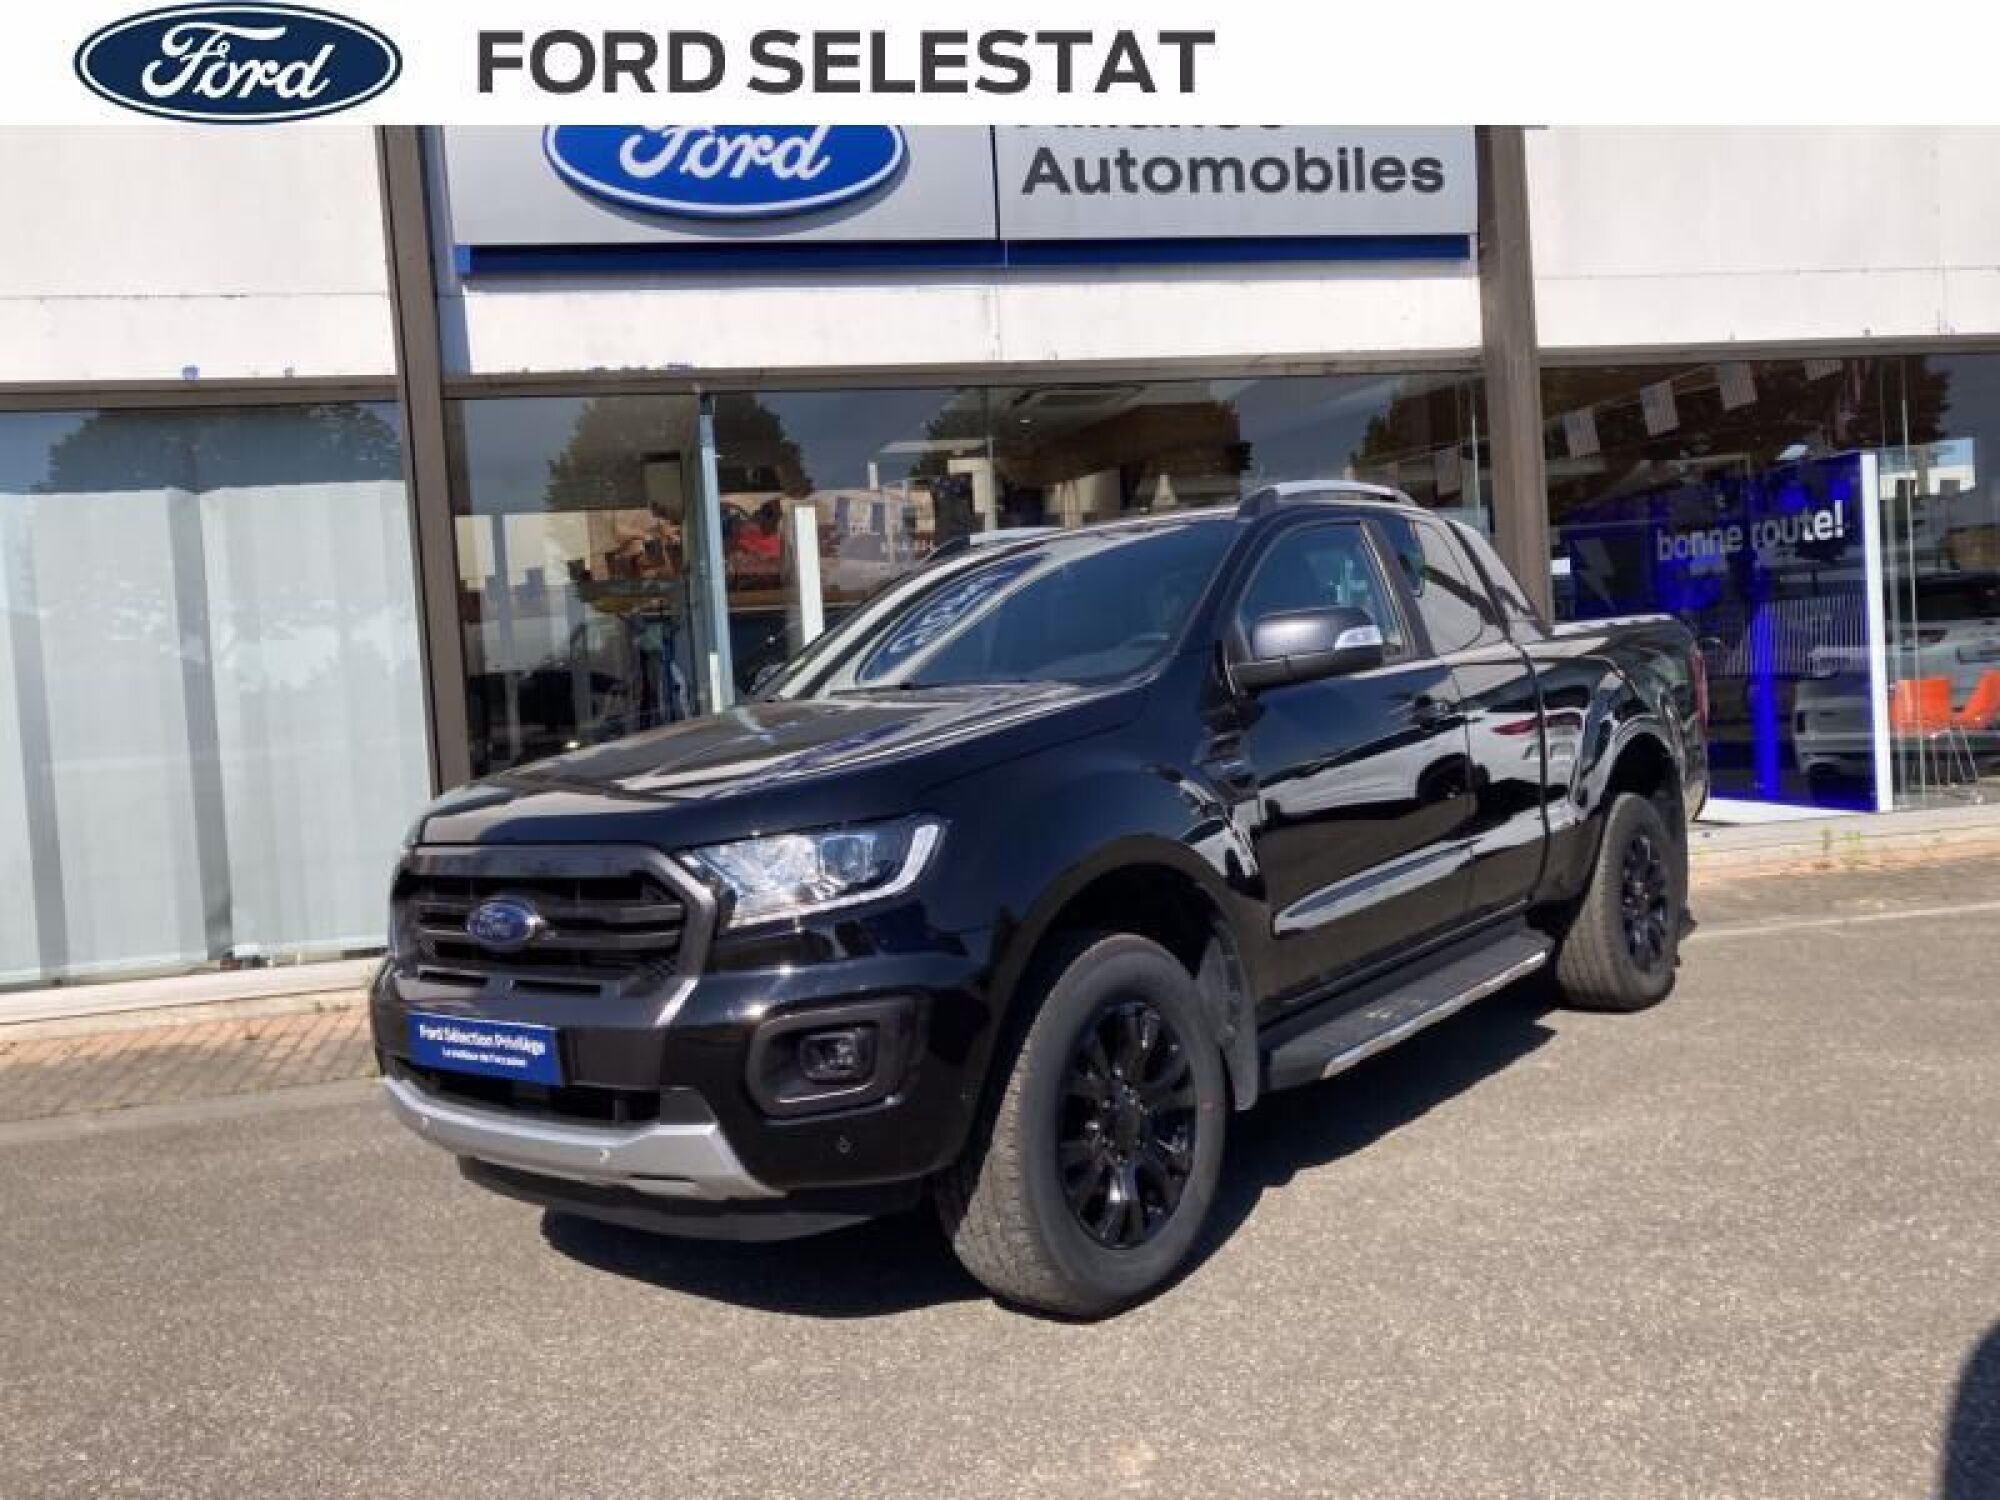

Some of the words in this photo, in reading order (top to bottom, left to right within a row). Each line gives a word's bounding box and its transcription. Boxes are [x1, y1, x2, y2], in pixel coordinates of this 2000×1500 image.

[619, 125, 831, 179] Ford
[1022, 147, 1443, 195] Automobiles
[1657, 524, 1743, 560] bonne
[1752, 499, 1844, 550] route!
